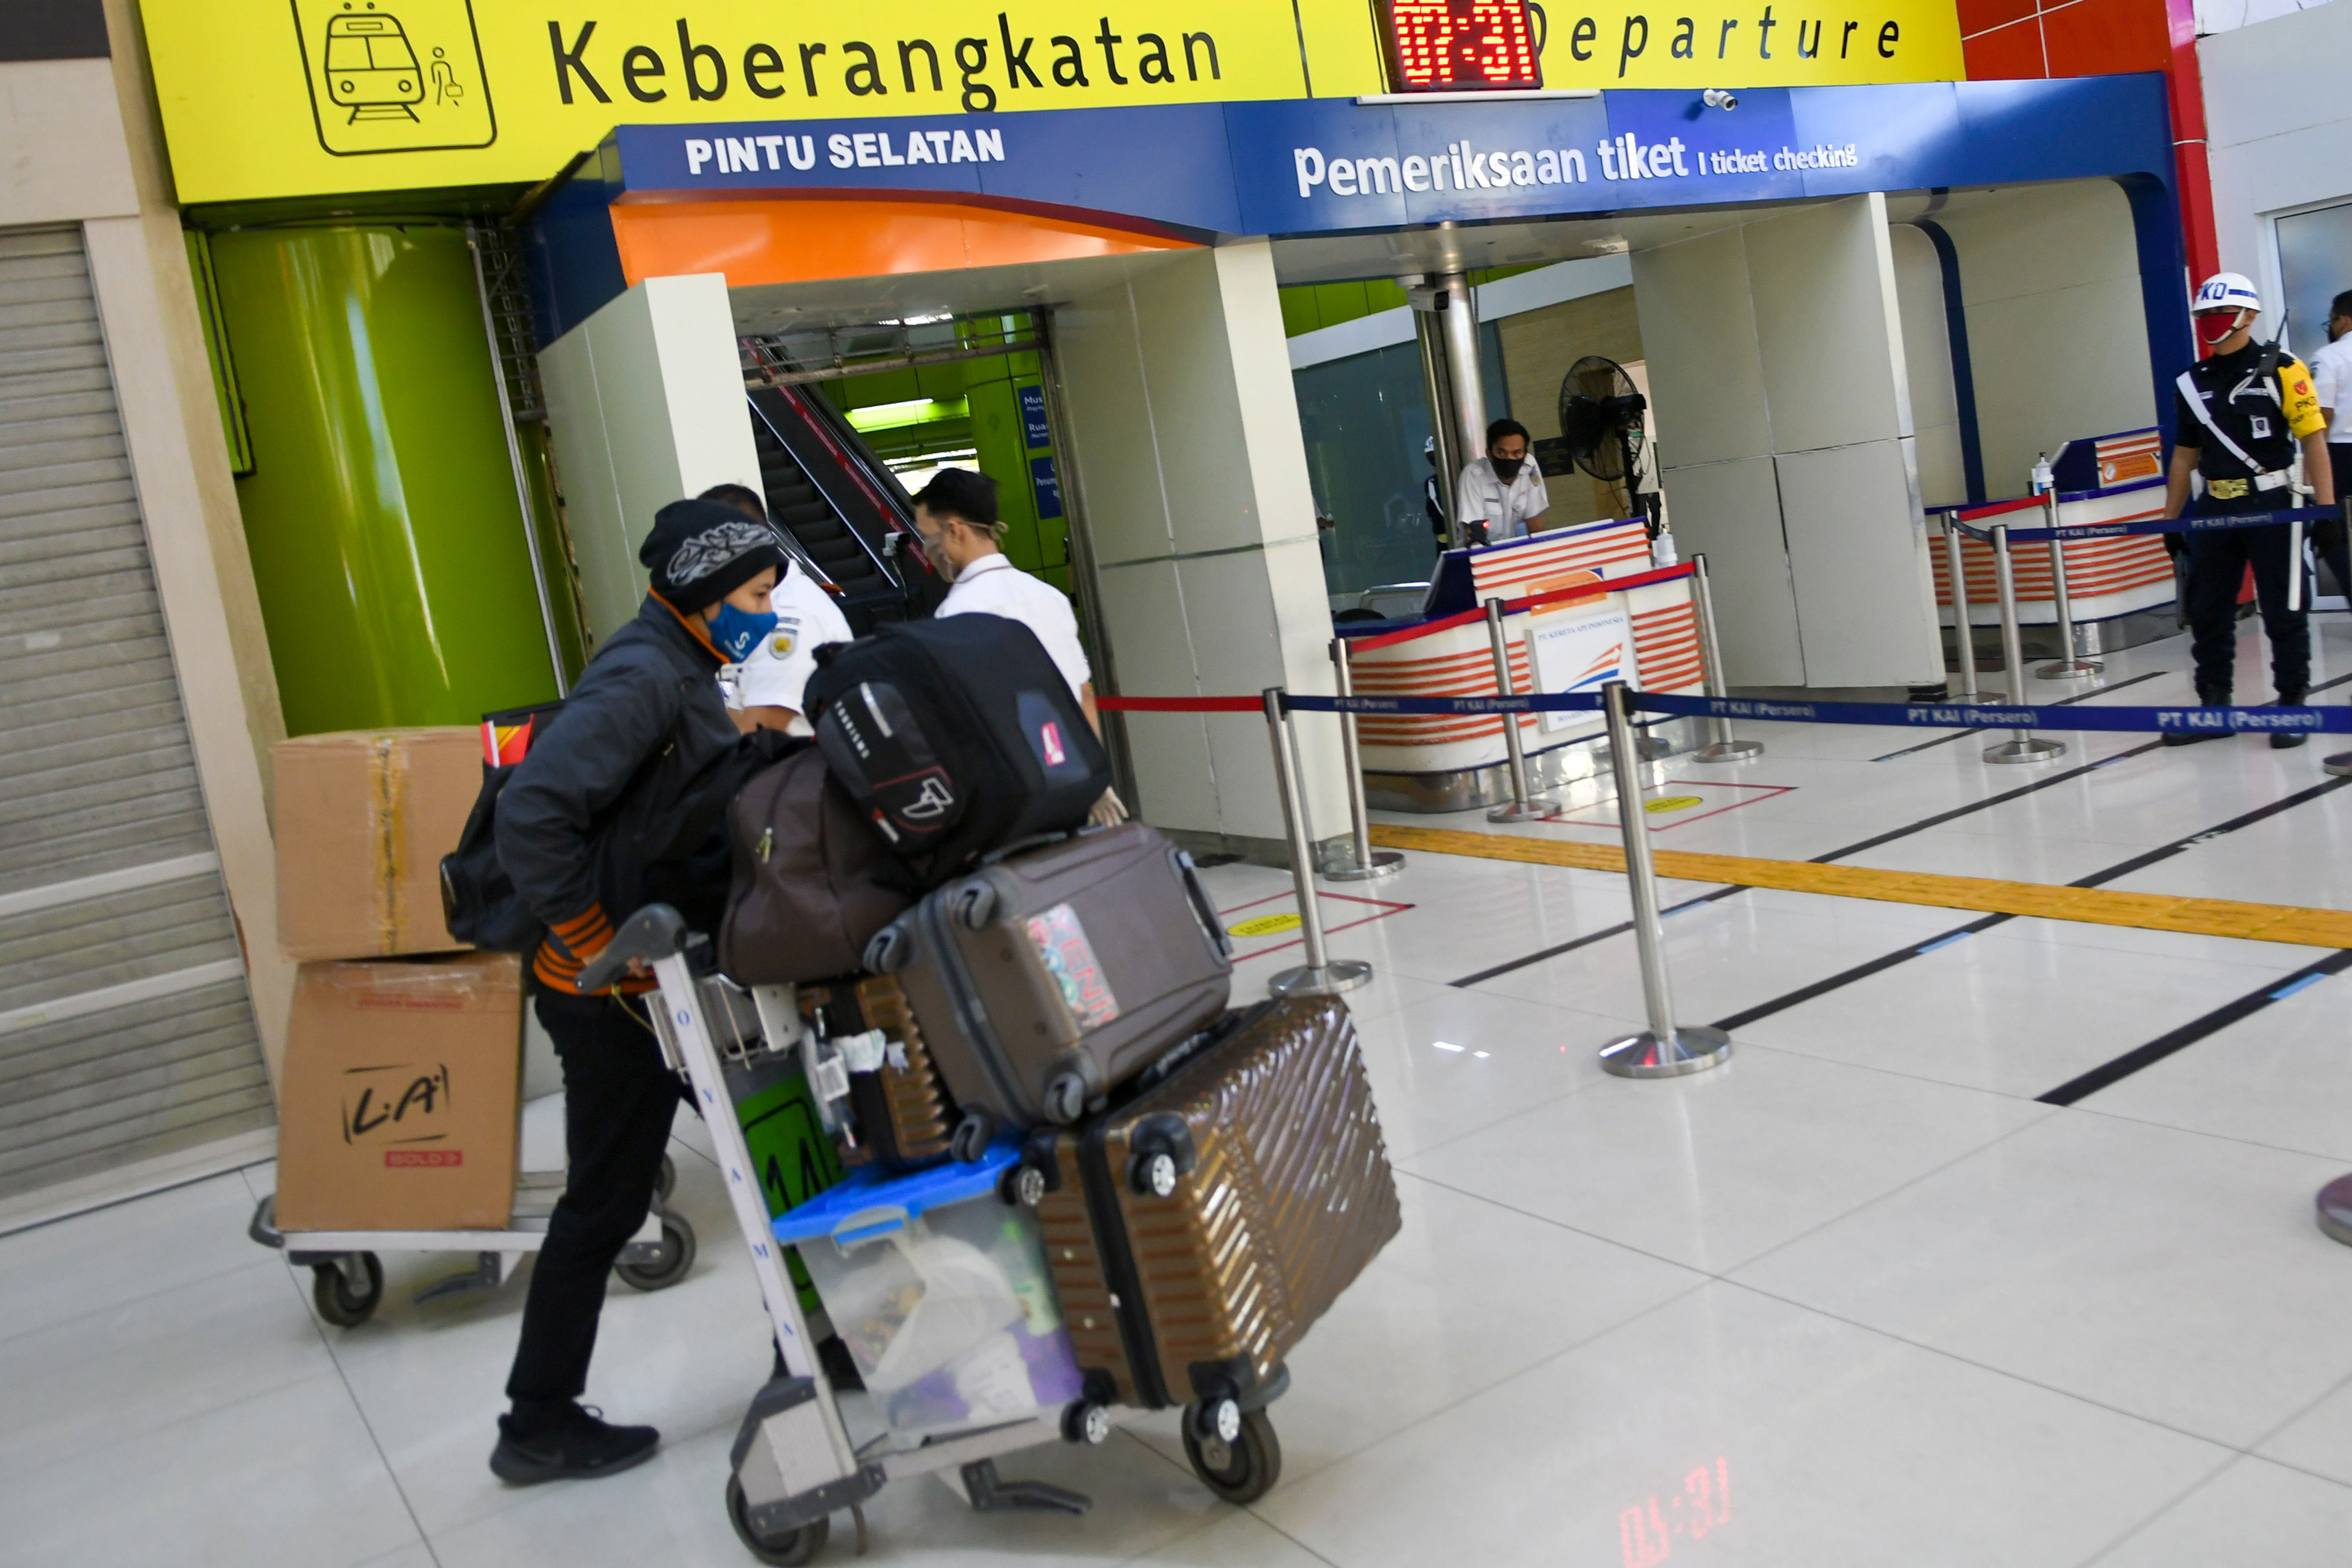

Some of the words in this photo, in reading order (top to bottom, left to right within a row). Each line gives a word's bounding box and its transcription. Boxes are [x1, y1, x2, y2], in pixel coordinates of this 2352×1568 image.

[547, 12, 1222, 112] Keberangkatan
[685, 135, 816, 175] PINTU
[828, 128, 1005, 169] SELATAN
[1294, 140, 1587, 198] Pemeriksaan
[1597, 132, 1688, 180] tiket
[1710, 149, 1768, 176] ticket
[1773, 142, 1859, 172] checking
[1907, 708, 1927, 722] PT
[1933, 710, 1960, 722] KAI
[1964, 709, 2039, 724] (Persero)
[2157, 713, 2182, 728] PT
[2187, 713, 2224, 728] KAI
[2229, 711, 2323, 729] (Persero)
